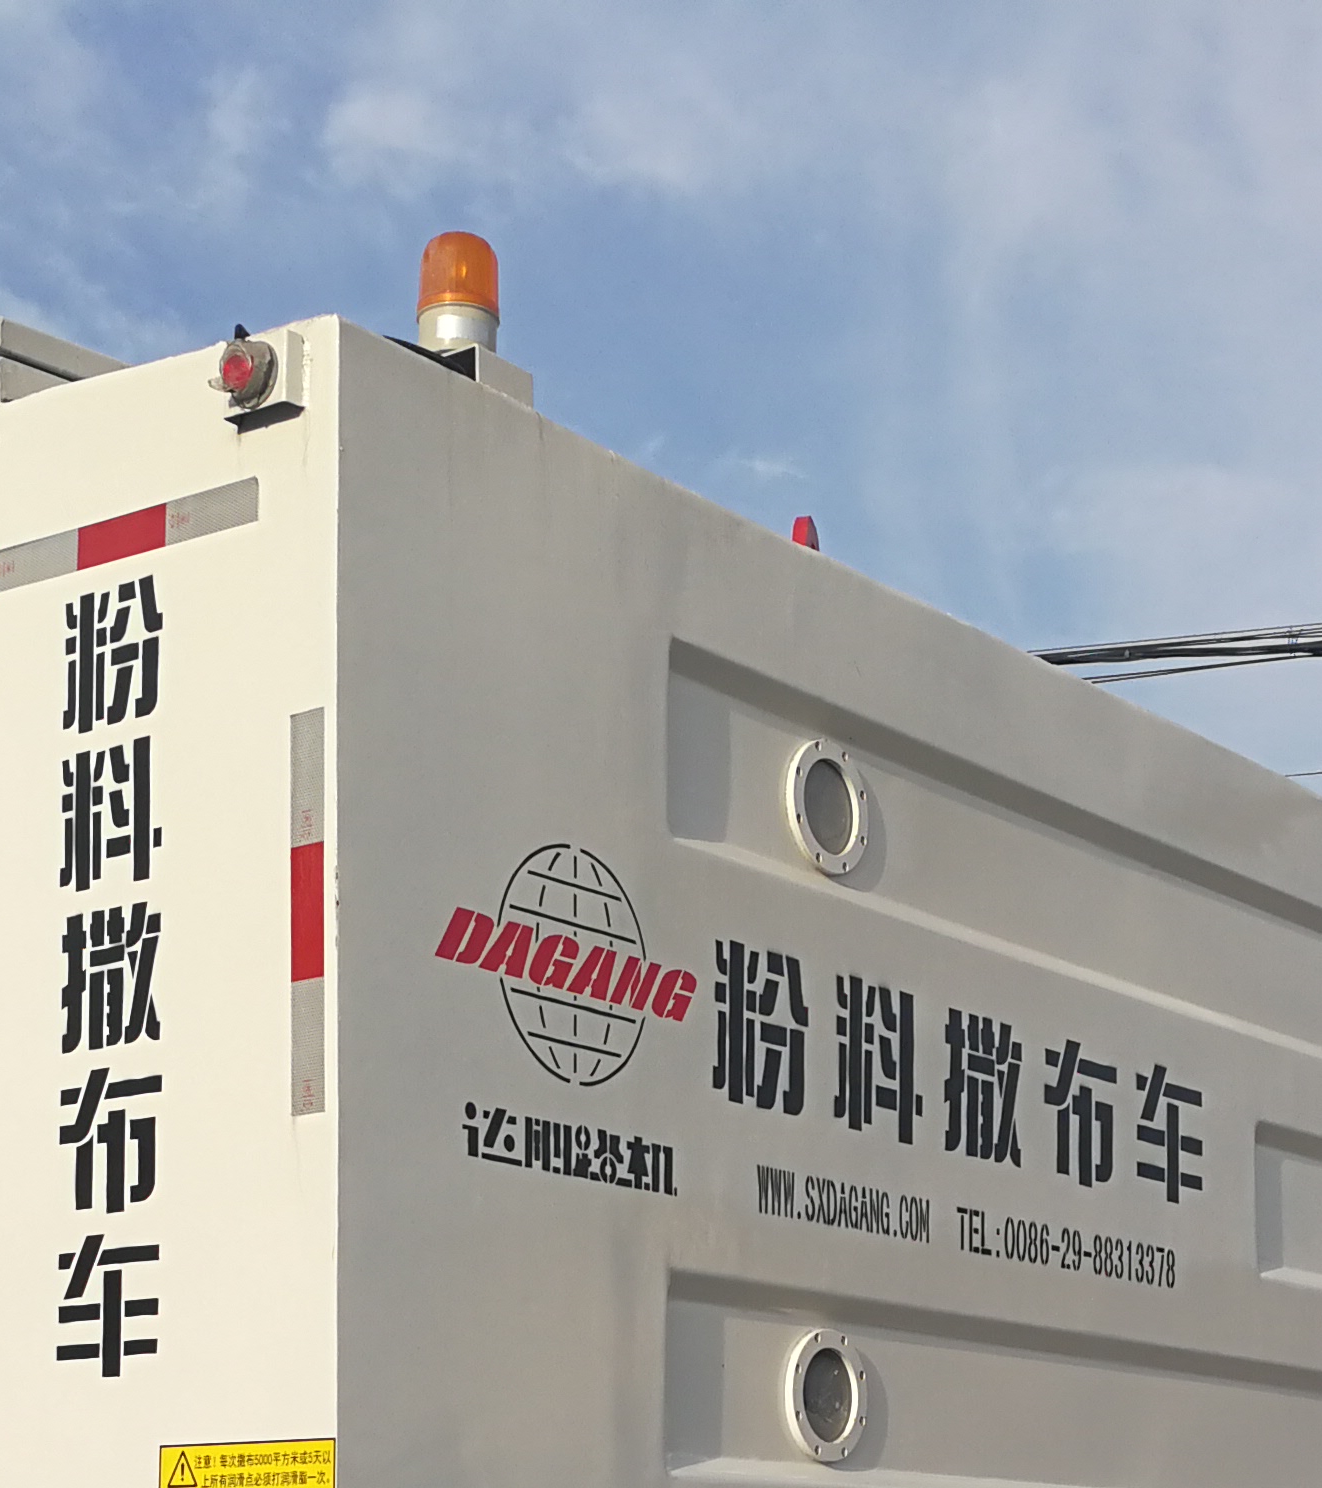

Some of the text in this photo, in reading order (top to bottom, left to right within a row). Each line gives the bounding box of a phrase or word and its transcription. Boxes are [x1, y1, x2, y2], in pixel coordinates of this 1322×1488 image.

[56, 573, 163, 1378] 粉料撒布车
[434, 906, 697, 1022] DAGANG
[712, 938, 1204, 1204] 粉料撒布车
[462, 1101, 678, 1197] 达刚路机
[756, 1164, 1177, 1289] WWW.SXDAGANG.COM TEL:0086-29-88313378
